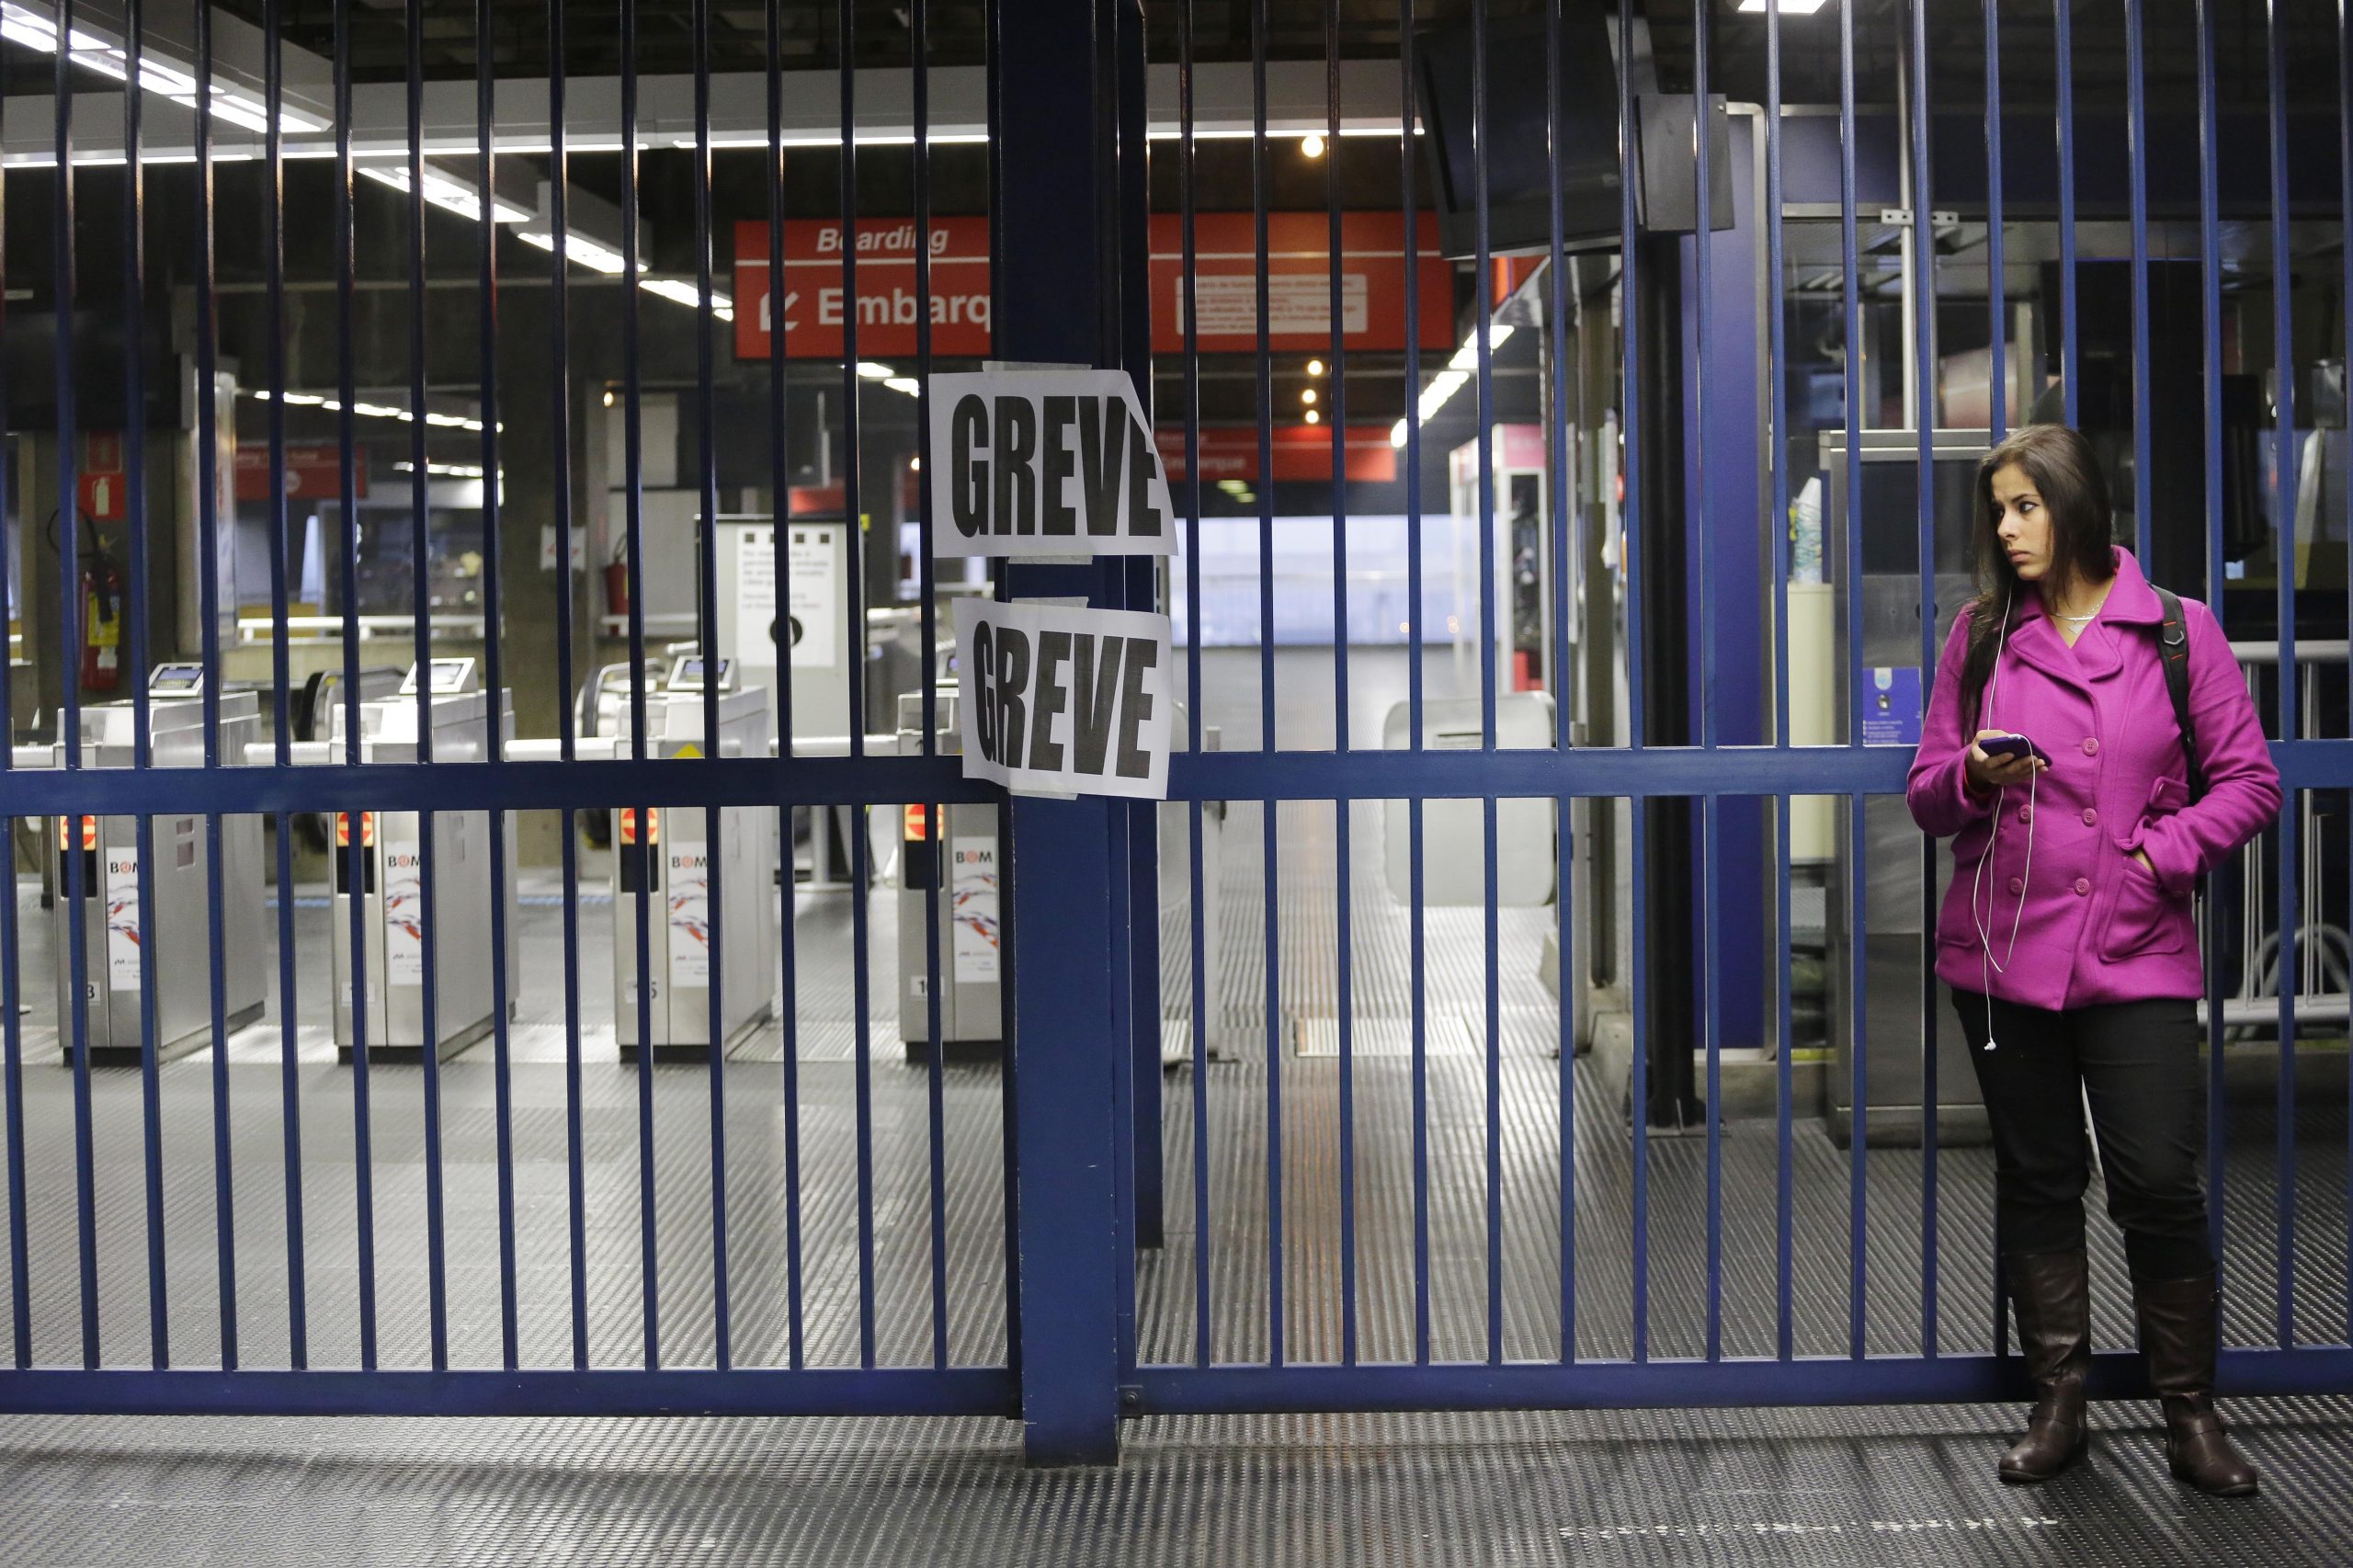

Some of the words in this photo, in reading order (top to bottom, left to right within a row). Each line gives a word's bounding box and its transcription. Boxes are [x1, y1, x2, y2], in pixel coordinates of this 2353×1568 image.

[816, 226, 949, 254] Bardig
[951, 393, 1162, 538] GREVE
[972, 619, 1158, 779] GREVE
